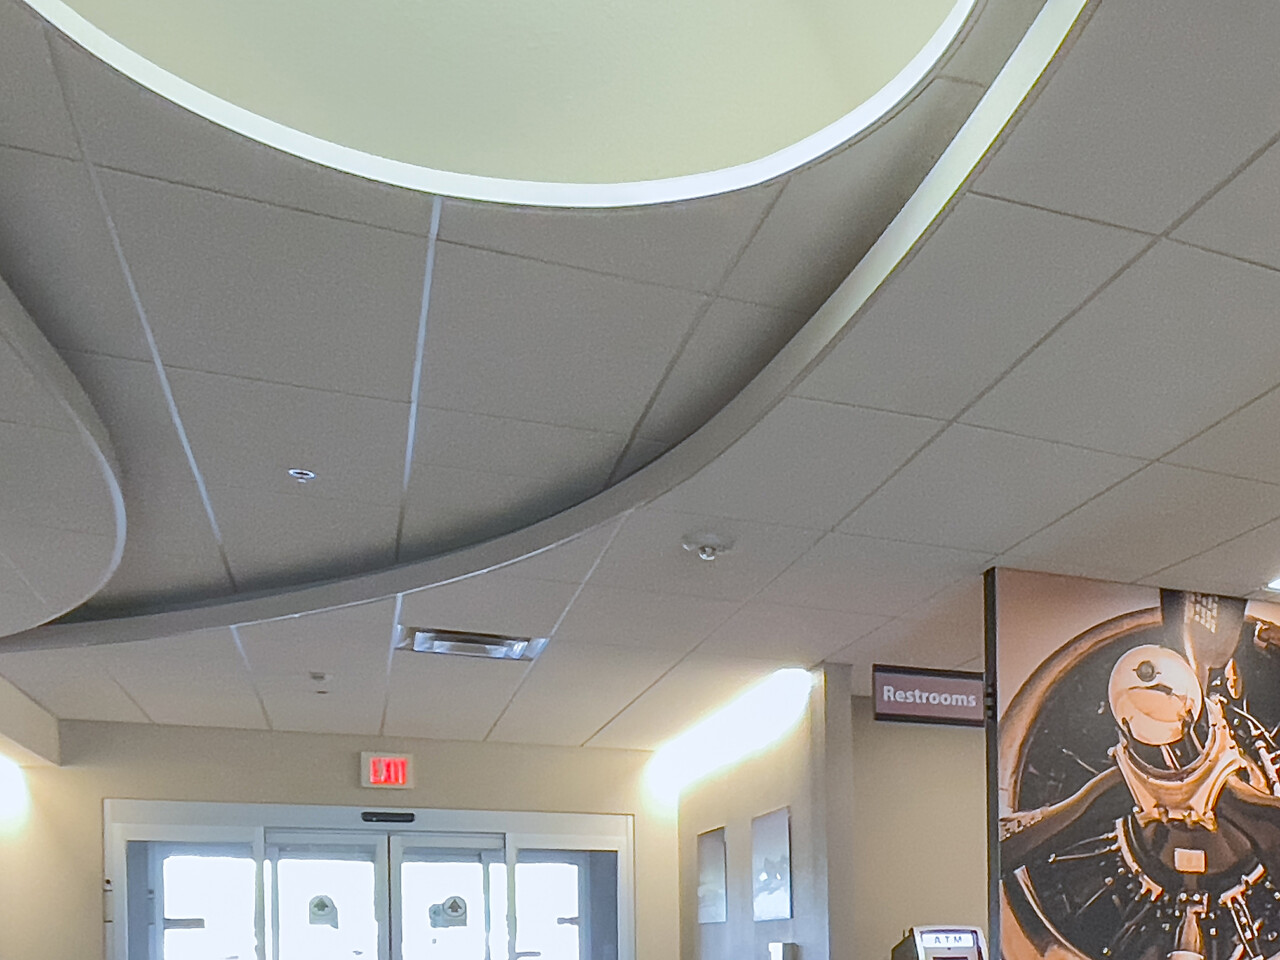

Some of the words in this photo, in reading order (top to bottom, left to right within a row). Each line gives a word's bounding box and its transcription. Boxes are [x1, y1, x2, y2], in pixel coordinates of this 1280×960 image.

[883, 685, 977, 707] Restrooms
[370, 757, 408, 785] EXIT
[934, 935, 962, 944] ATM
